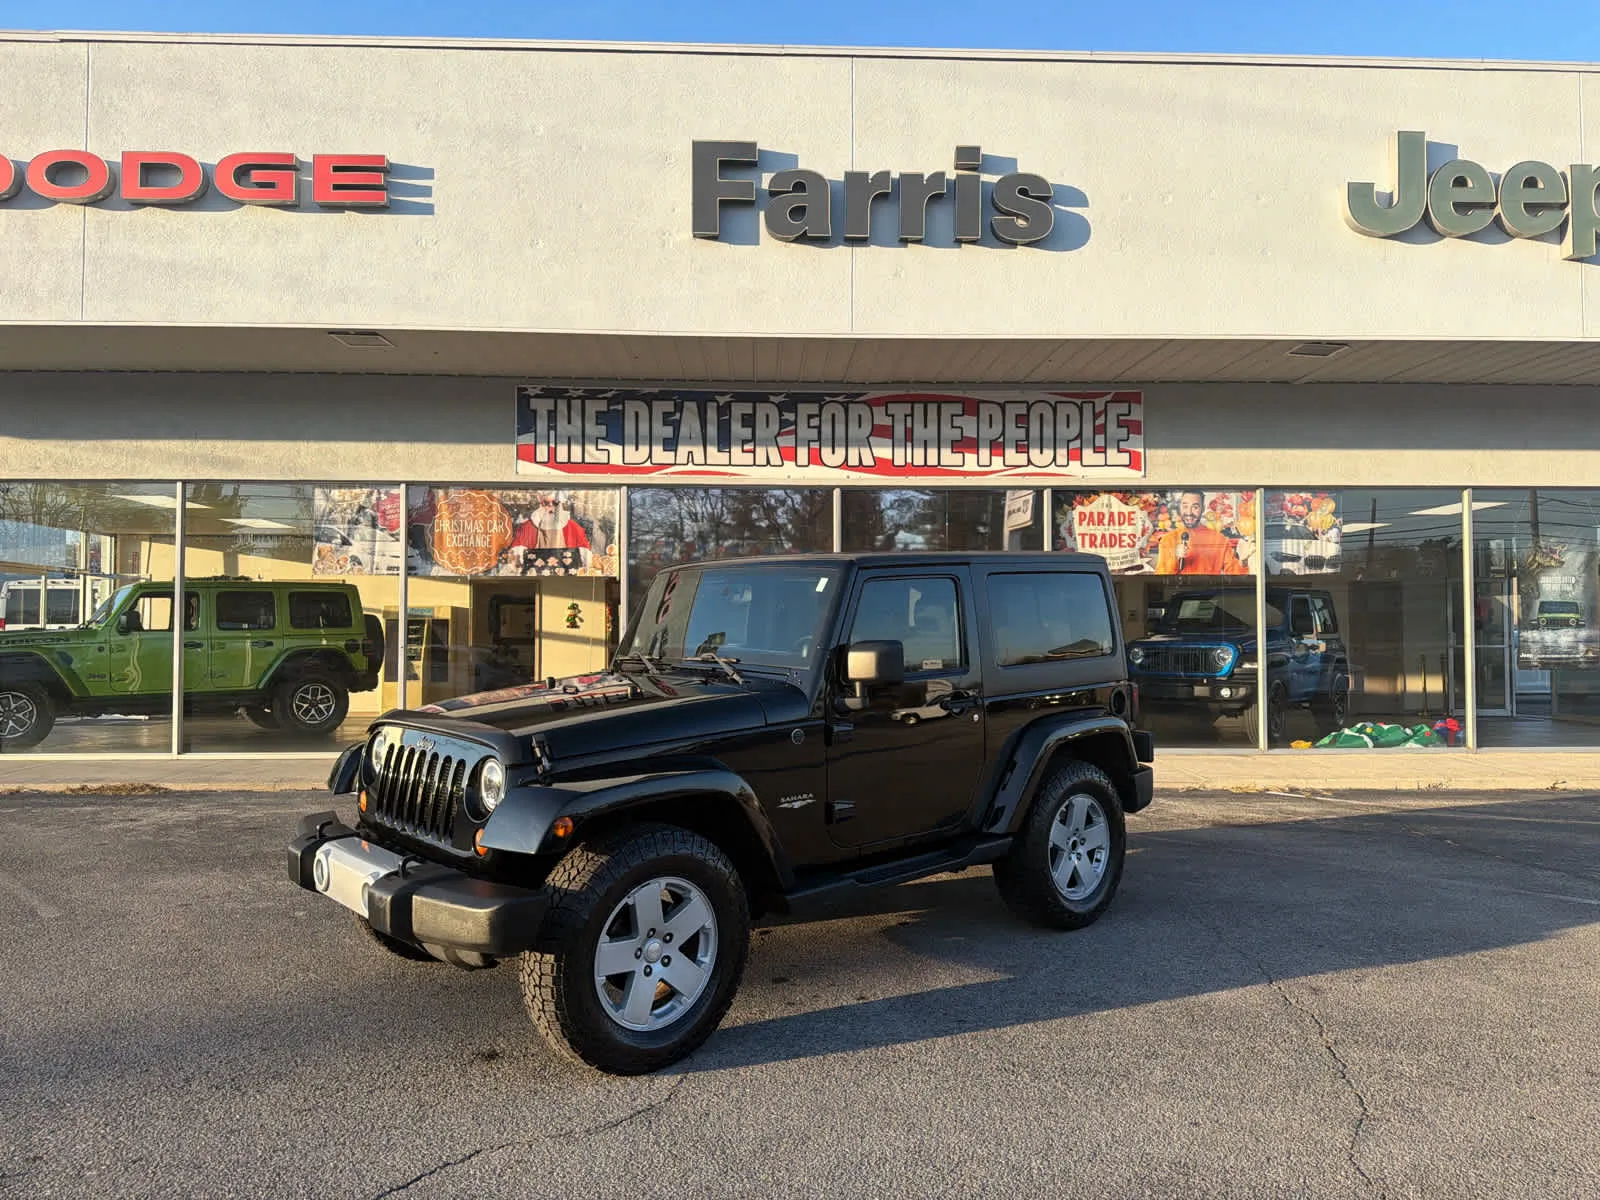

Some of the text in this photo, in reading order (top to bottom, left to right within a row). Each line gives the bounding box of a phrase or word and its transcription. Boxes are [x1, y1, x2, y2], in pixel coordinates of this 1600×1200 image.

[0, 150, 390, 207] ODGE
[692, 139, 1055, 245] Farris
[529, 398, 1132, 468] THE DEALER FOR THE PEOPLE
[434, 519, 505, 533] CHRISTMAS CAR
[1078, 511, 1136, 527] PARADE
[446, 533, 492, 547] EXCHANGE
[1077, 532, 1137, 548] TRADES
[780, 792, 814, 802] SAHARA
